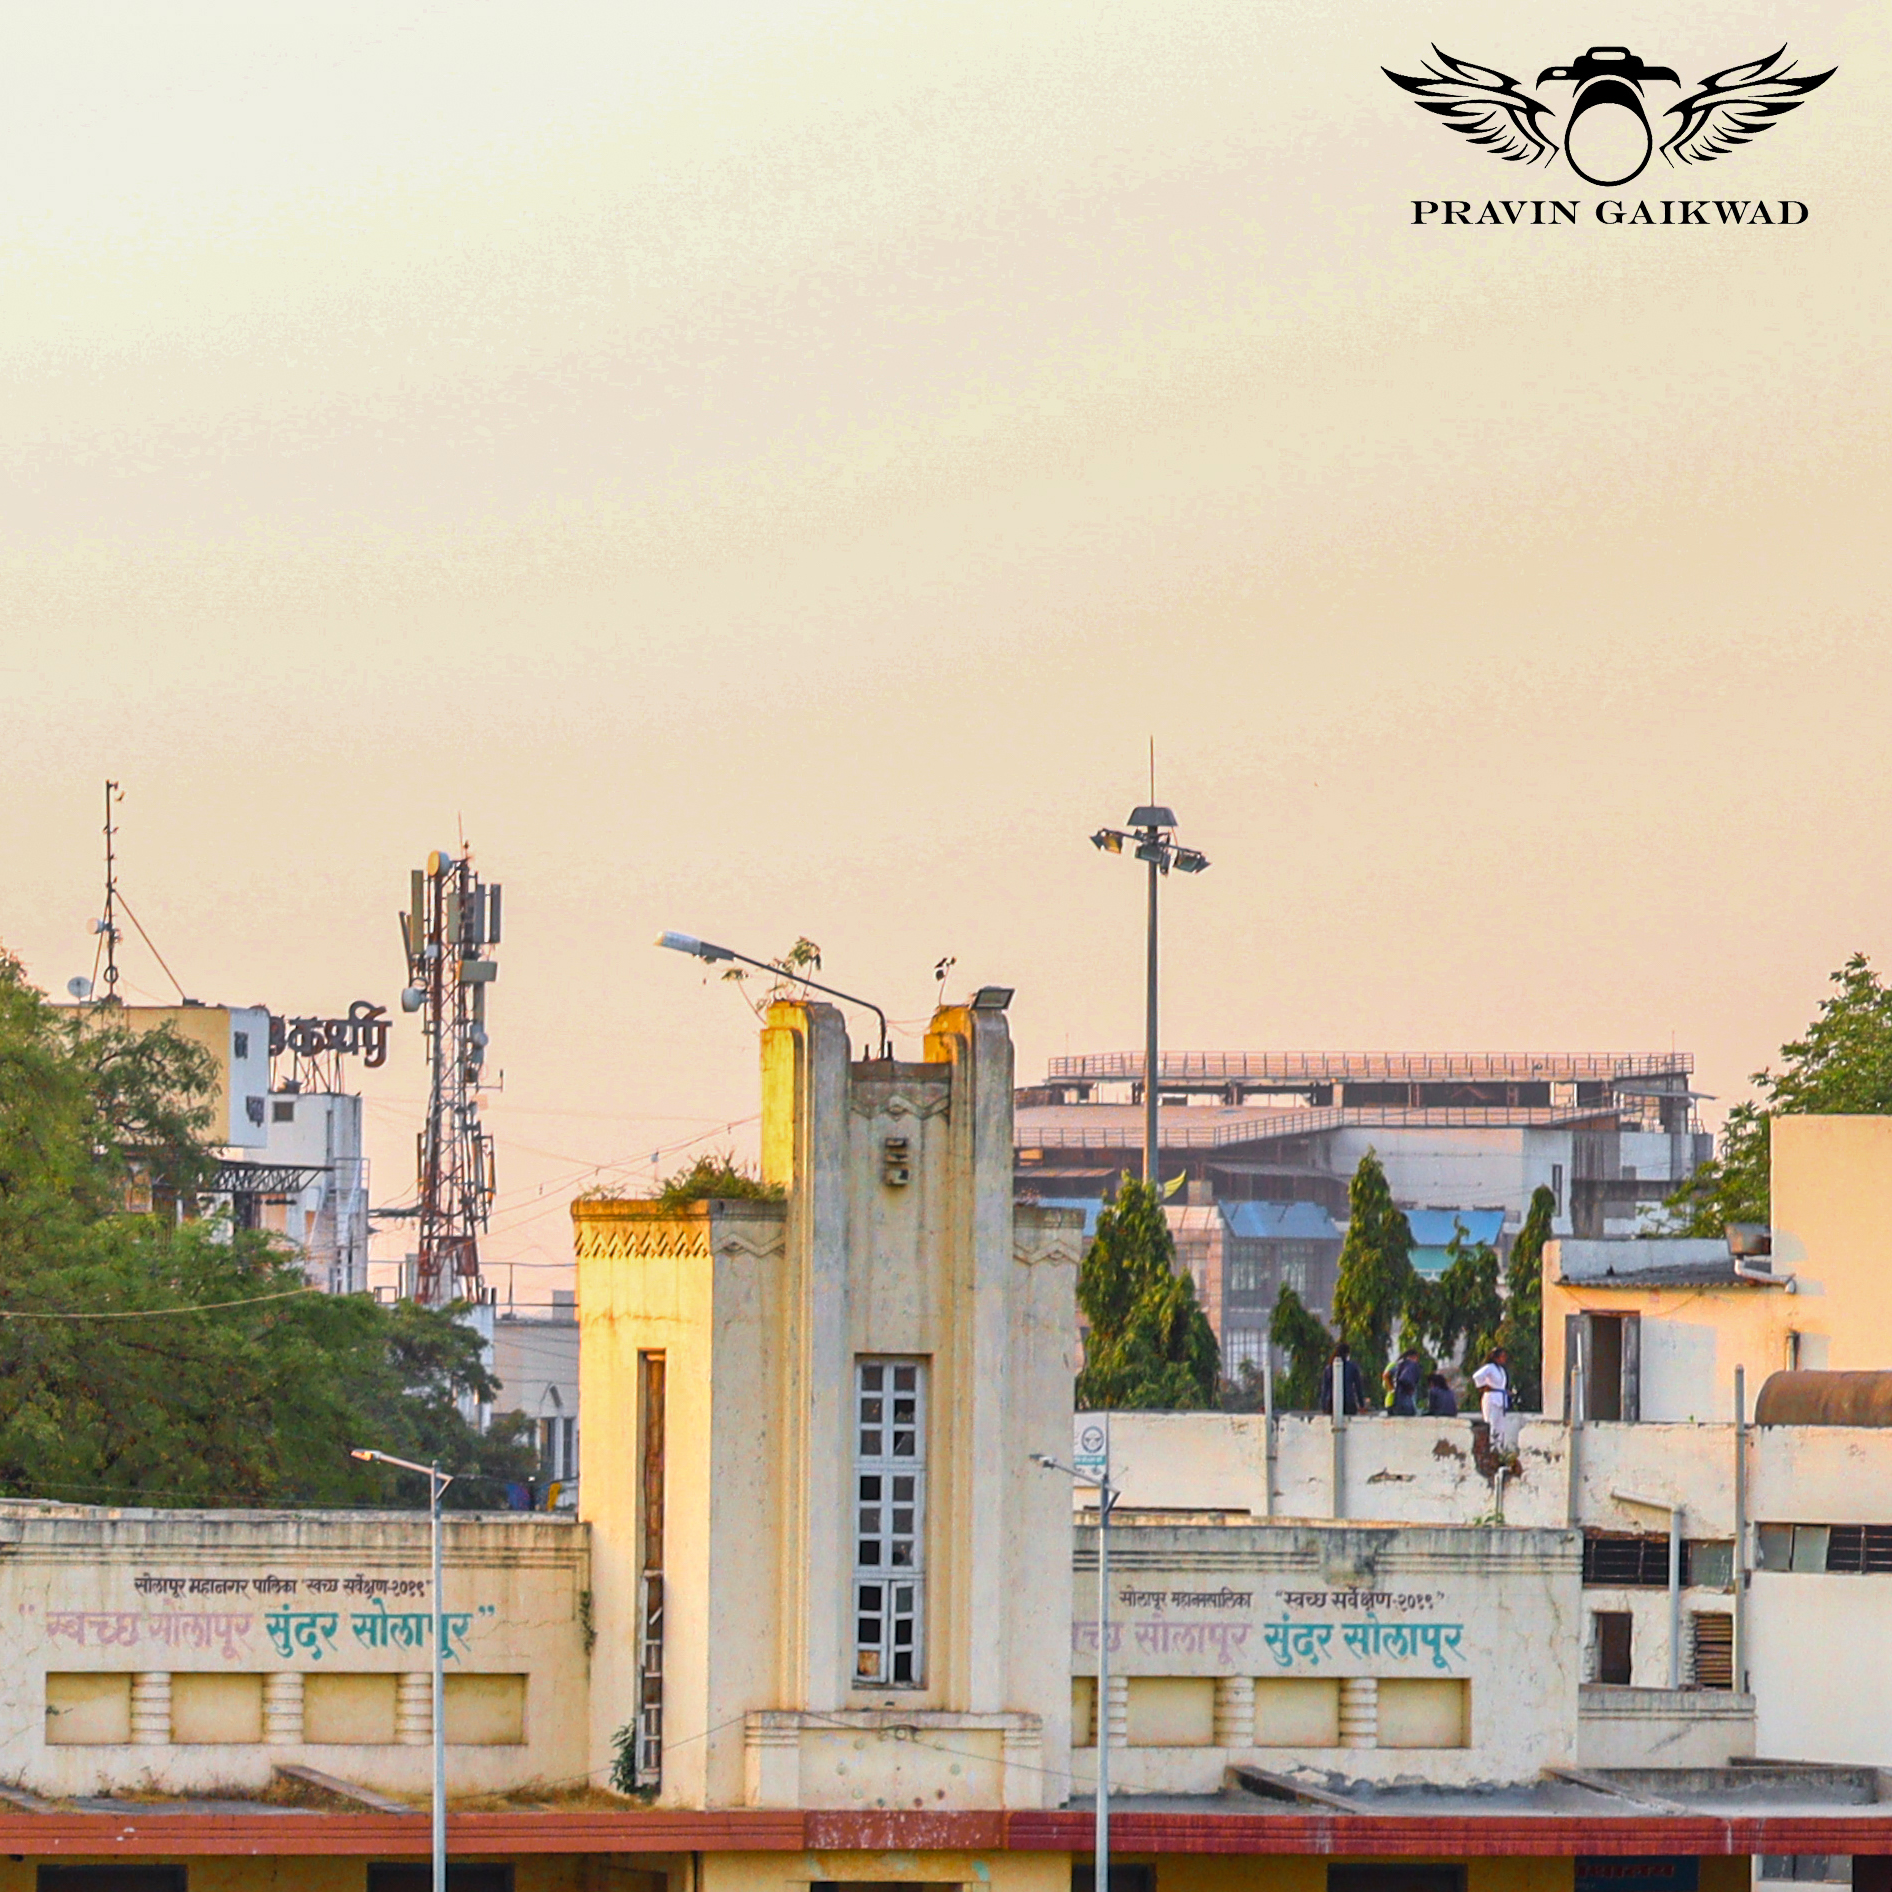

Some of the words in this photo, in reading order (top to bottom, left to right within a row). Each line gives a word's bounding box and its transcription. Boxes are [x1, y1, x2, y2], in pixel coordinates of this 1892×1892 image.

[134, 1573, 186, 1599] सोलापूर
[253, 1575, 297, 1595] पालिका
[1119, 1586, 1168, 1611] सोलापूर
[265, 1604, 340, 1660] सुंदर
[1135, 1614, 1254, 1665] सोलापूर
[1264, 1613, 1337, 1668] सुंदर
[1341, 1611, 1468, 1672] सोलापूर
